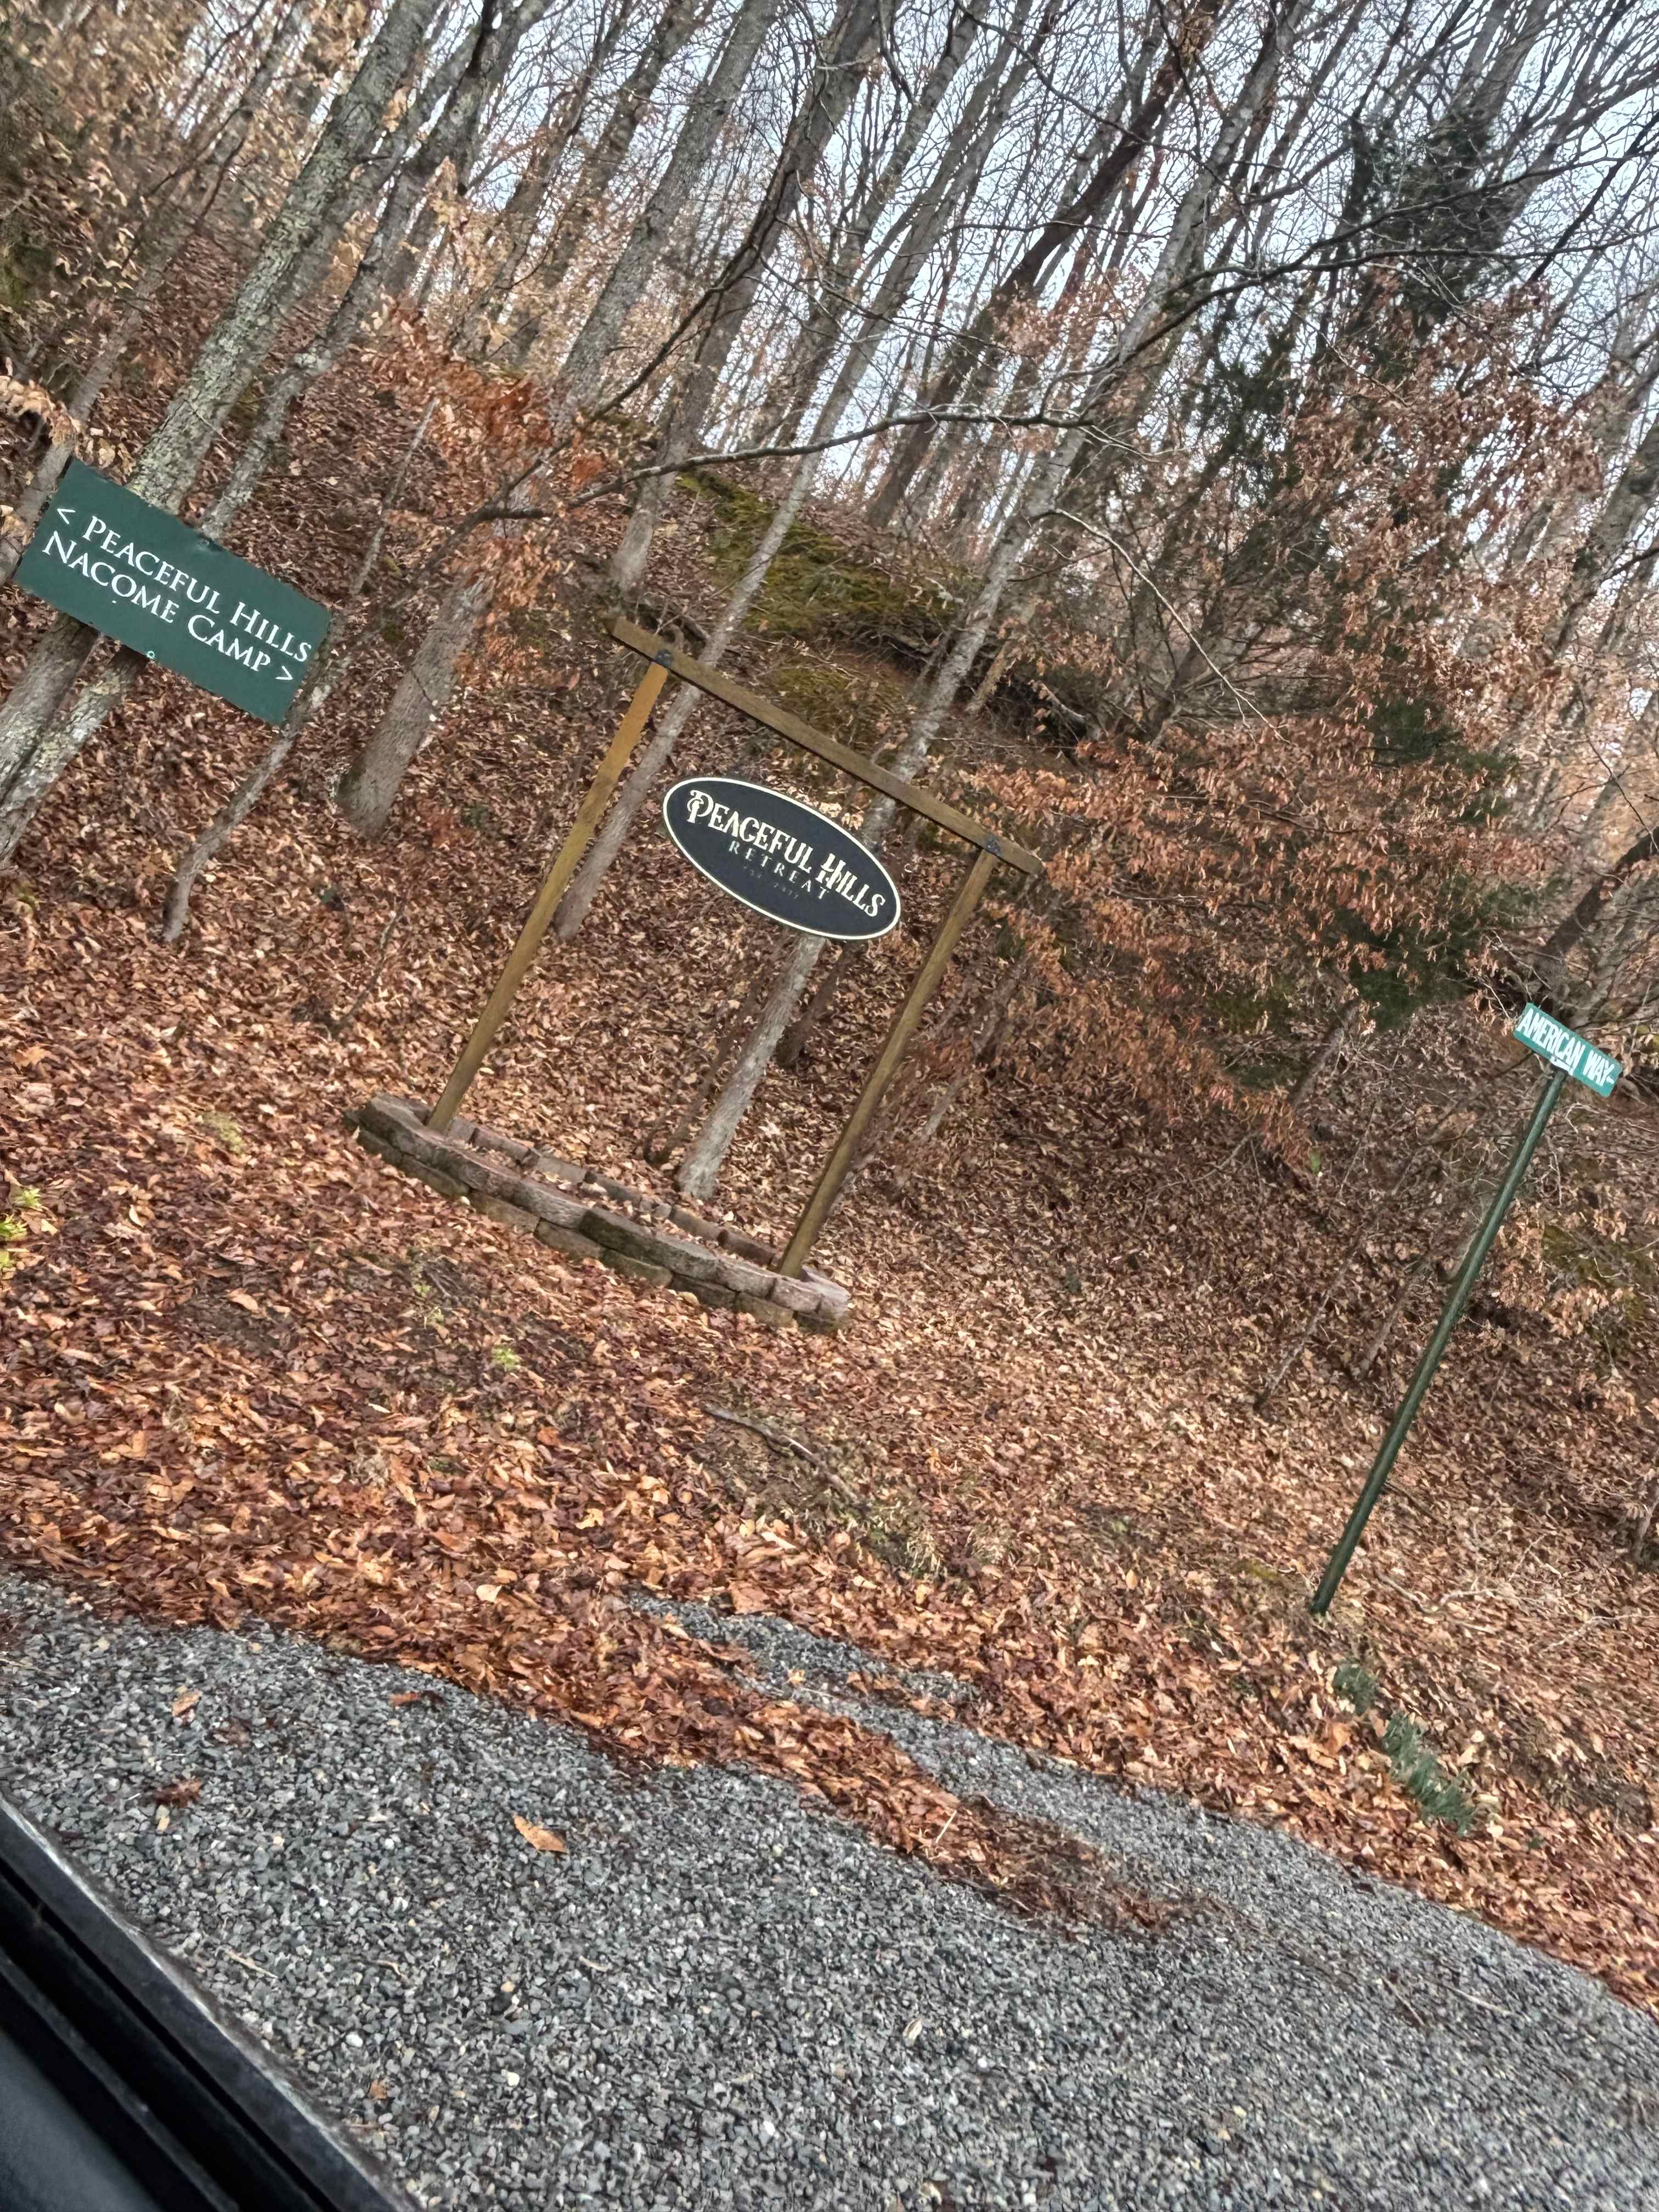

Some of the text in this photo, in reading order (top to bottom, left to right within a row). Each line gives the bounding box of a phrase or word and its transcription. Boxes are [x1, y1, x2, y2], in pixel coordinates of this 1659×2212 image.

[42, 531, 270, 672] NACOME CAMP
[83, 516, 312, 662] PEACEFUL HILLS
[686, 789, 814, 873] PEACEFUL
[815, 853, 886, 917] HILLS
[729, 840, 830, 899] RETREAT
[1516, 1008, 1585, 1070] AMERICAN
